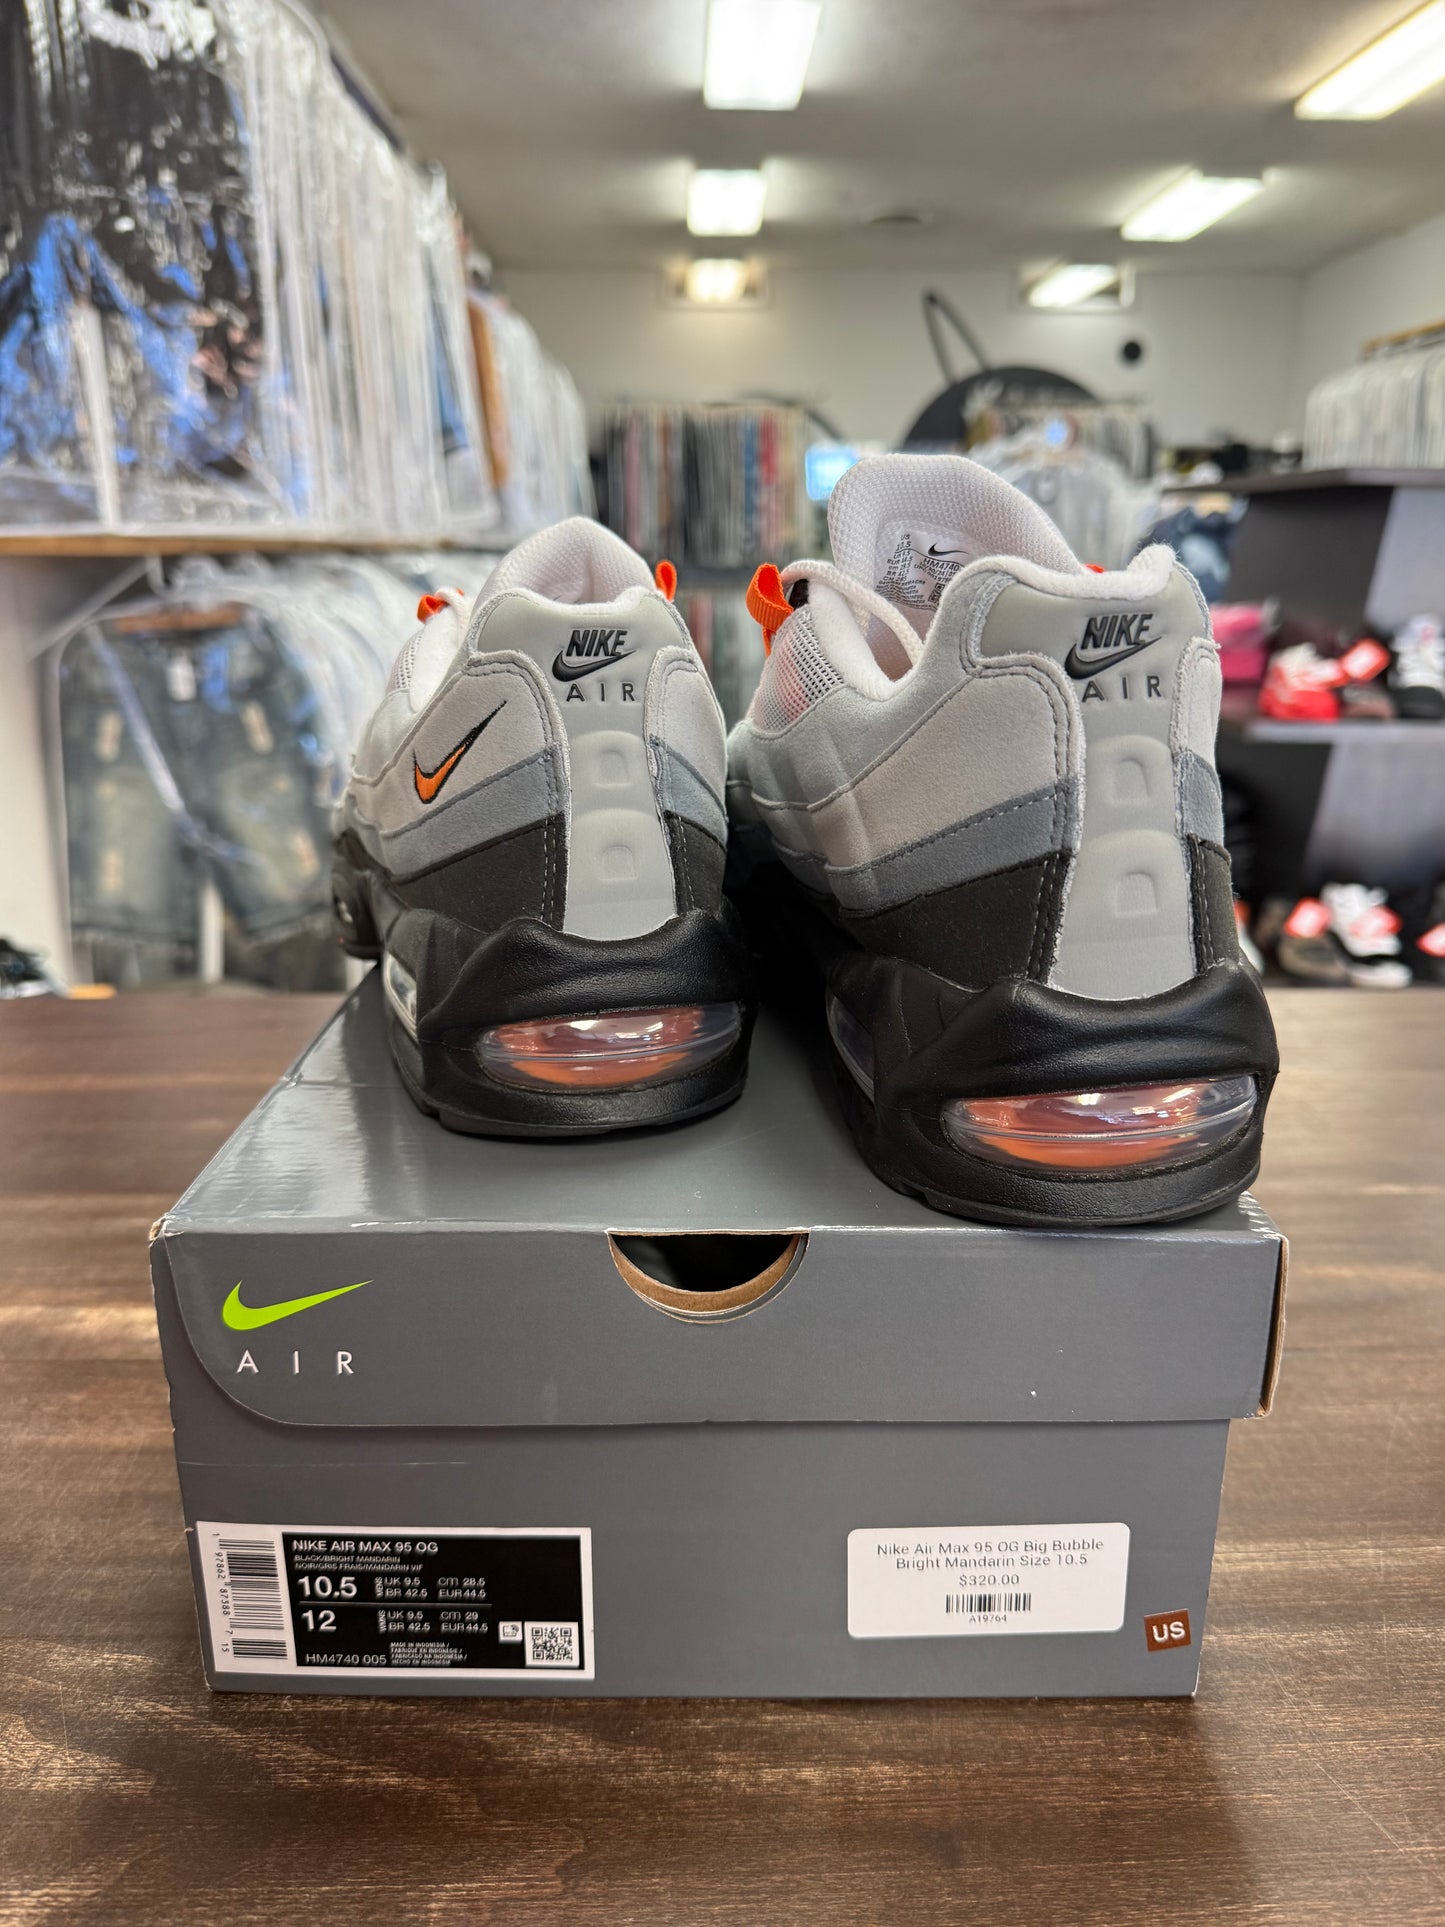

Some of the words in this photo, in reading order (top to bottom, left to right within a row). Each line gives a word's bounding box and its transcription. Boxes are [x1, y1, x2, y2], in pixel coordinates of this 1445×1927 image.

[1080, 613, 1154, 651] NIKE
[565, 629, 628, 657] NIKE
[566, 682, 635, 702] AIR
[1081, 675, 1162, 703] AIR
[235, 1349, 355, 1376] AIR
[293, 1539, 328, 1551] NIKE
[331, 1540, 356, 1552] AIR
[359, 1540, 392, 1552] MAX
[395, 1541, 412, 1552] 95
[416, 1541, 439, 1553] OG
[877, 1543, 909, 1555] Nike
[914, 1542, 932, 1554] Air
[938, 1542, 969, 1554] Max
[974, 1541, 992, 1553] 95
[997, 1541, 1019, 1552] OG
[1024, 1540, 1047, 1554] Big
[1052, 1538, 1104, 1551] Bubble
[214, 1551, 227, 1580] 97862
[356, 1555, 401, 1564] MANDARIN
[896, 1556, 940, 1571] Bright
[945, 1555, 1015, 1568] Mandarin
[1020, 1554, 1051, 1566] Size
[1057, 1553, 1088, 1566] 10.5
[298, 1575, 358, 1598] 10.5
[384, 1576, 402, 1586] UK
[404, 1576, 421, 1587] 9.5
[463, 1577, 486, 1587] 28.5
[959, 1574, 1020, 1587] $320.00
[385, 1588, 402, 1597] BR
[405, 1588, 428, 1598] 42.5
[439, 1588, 462, 1598] EUR
[463, 1588, 487, 1598] 44.5
[301, 1609, 337, 1632] 12
[387, 1610, 405, 1620] UK
[406, 1610, 424, 1620] 9.5
[465, 1611, 479, 1621] 29
[389, 1621, 405, 1631] BR
[408, 1622, 431, 1632] 42.5
[441, 1622, 465, 1632] EUR
[466, 1622, 489, 1632] 44.5
[1152, 1620, 1186, 1643] US
[306, 1653, 360, 1665] HM4740
[363, 1654, 387, 1665] 005
